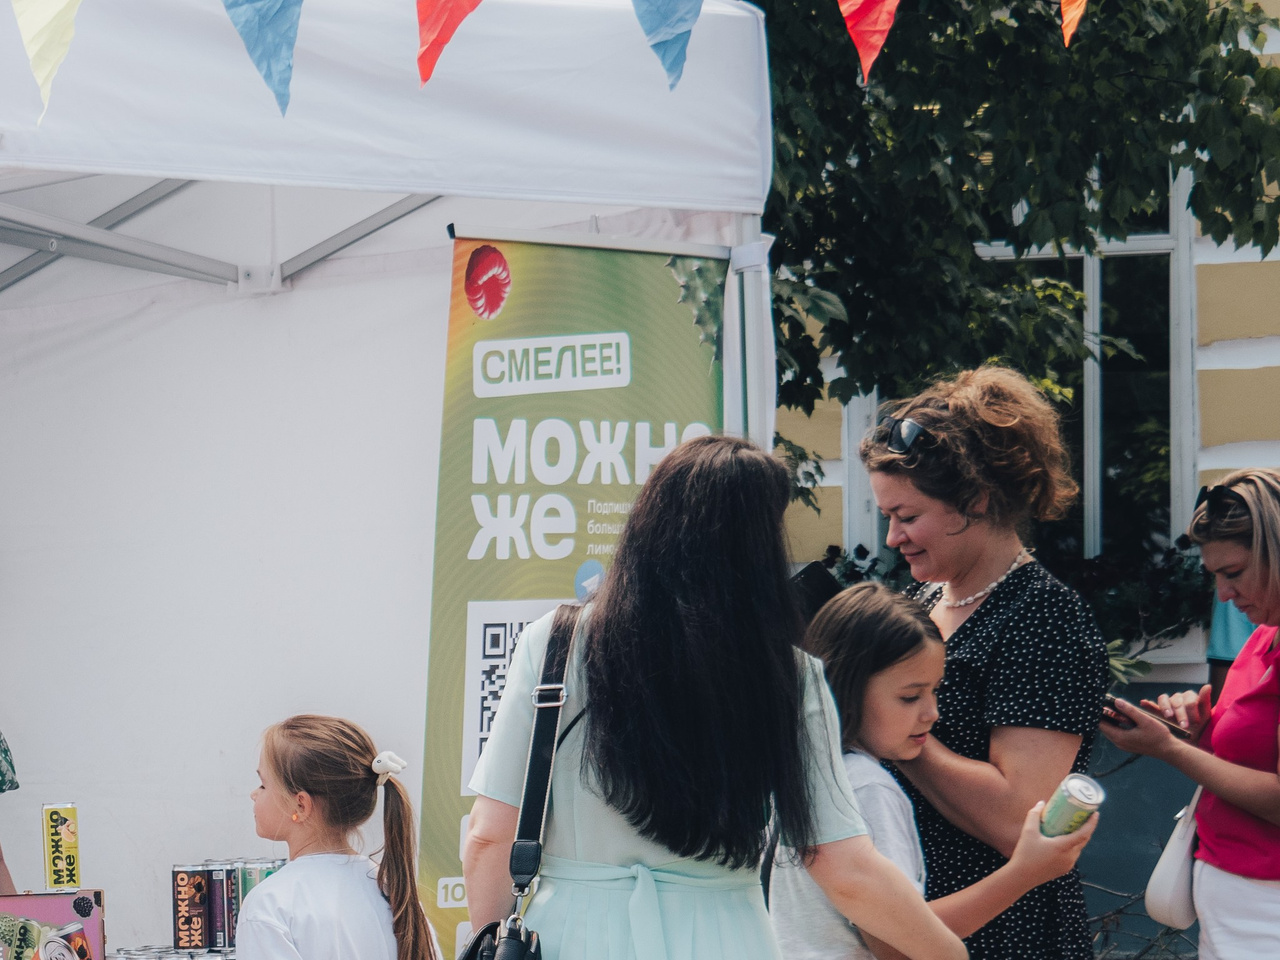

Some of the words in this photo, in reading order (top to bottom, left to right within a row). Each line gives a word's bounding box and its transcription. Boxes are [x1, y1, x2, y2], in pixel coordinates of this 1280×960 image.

[481, 341, 622, 384] СМЕЛЕЕ!
[471, 417, 713, 486] МОЖН
[587, 499, 632, 515] Подпиш
[586, 544, 616, 556] лимо
